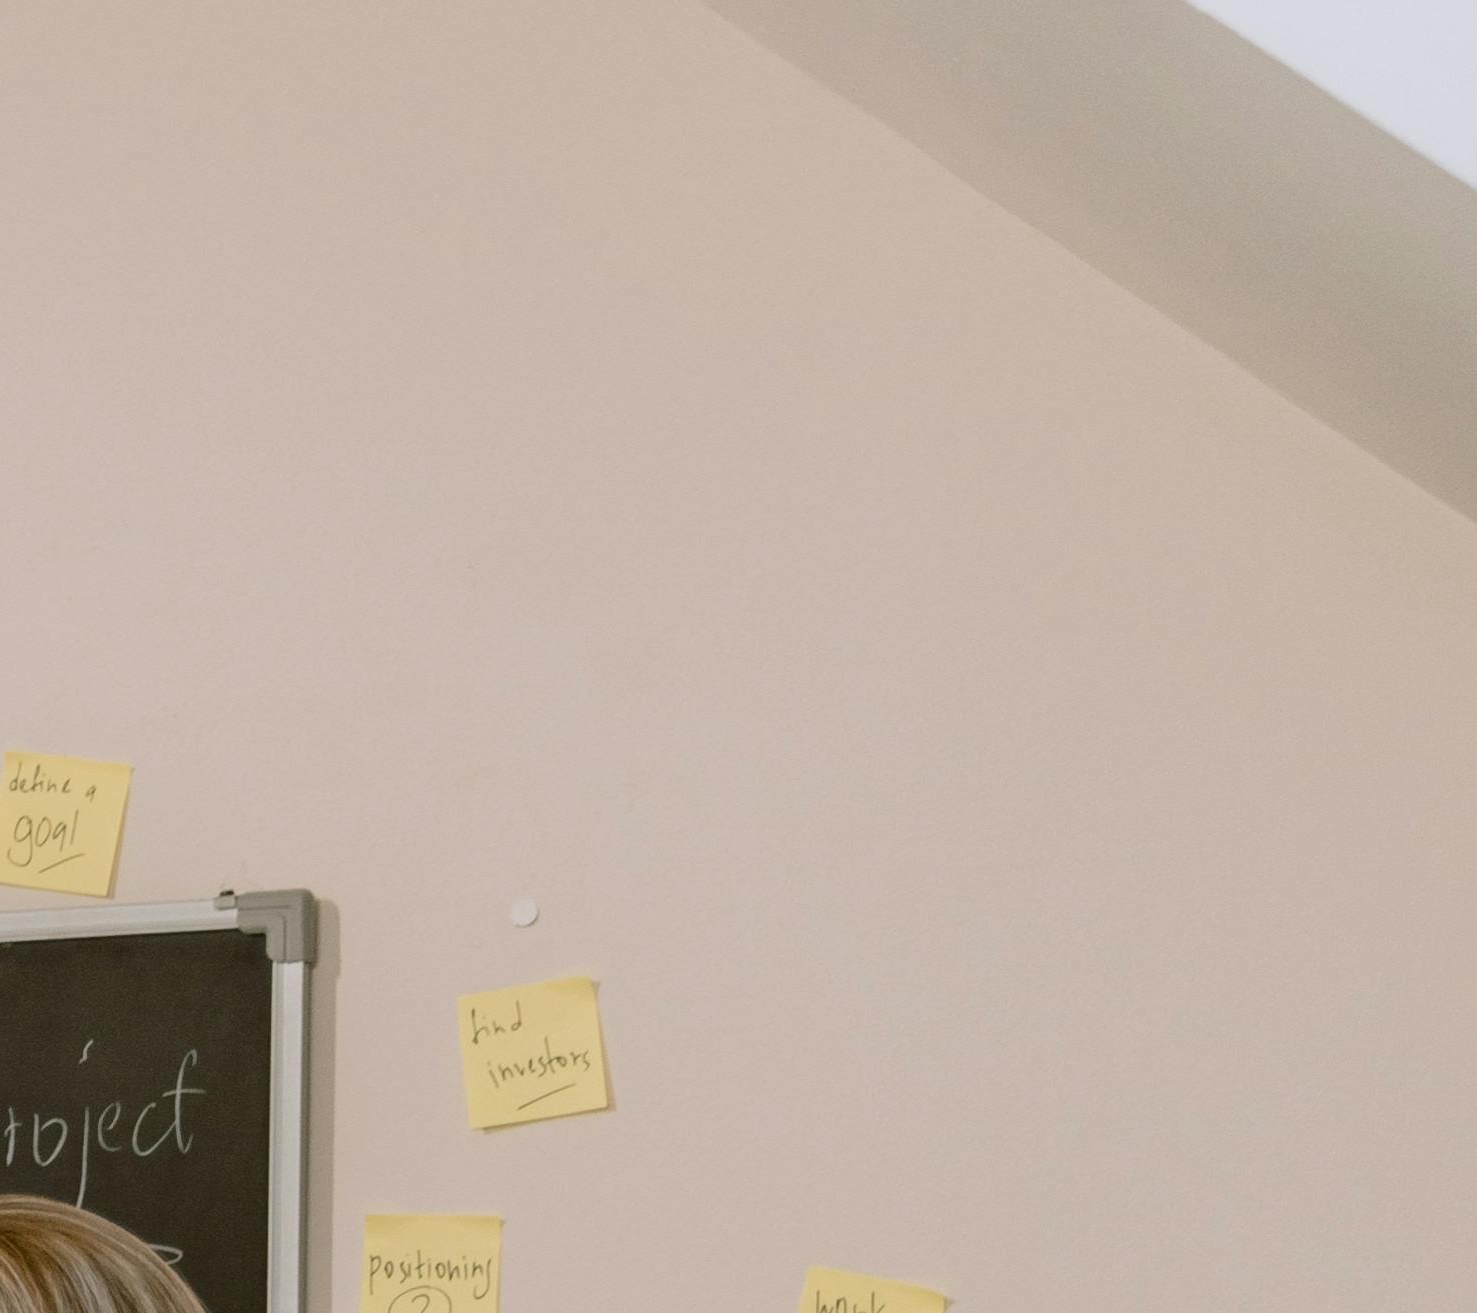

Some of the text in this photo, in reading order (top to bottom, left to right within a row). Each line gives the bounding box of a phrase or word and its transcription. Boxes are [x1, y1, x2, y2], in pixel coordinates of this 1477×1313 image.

[7, 809, 80, 868] goal
[471, 999, 522, 1045] find
[487, 1035, 591, 1089] investors
[369, 1249, 492, 1301] positioning
